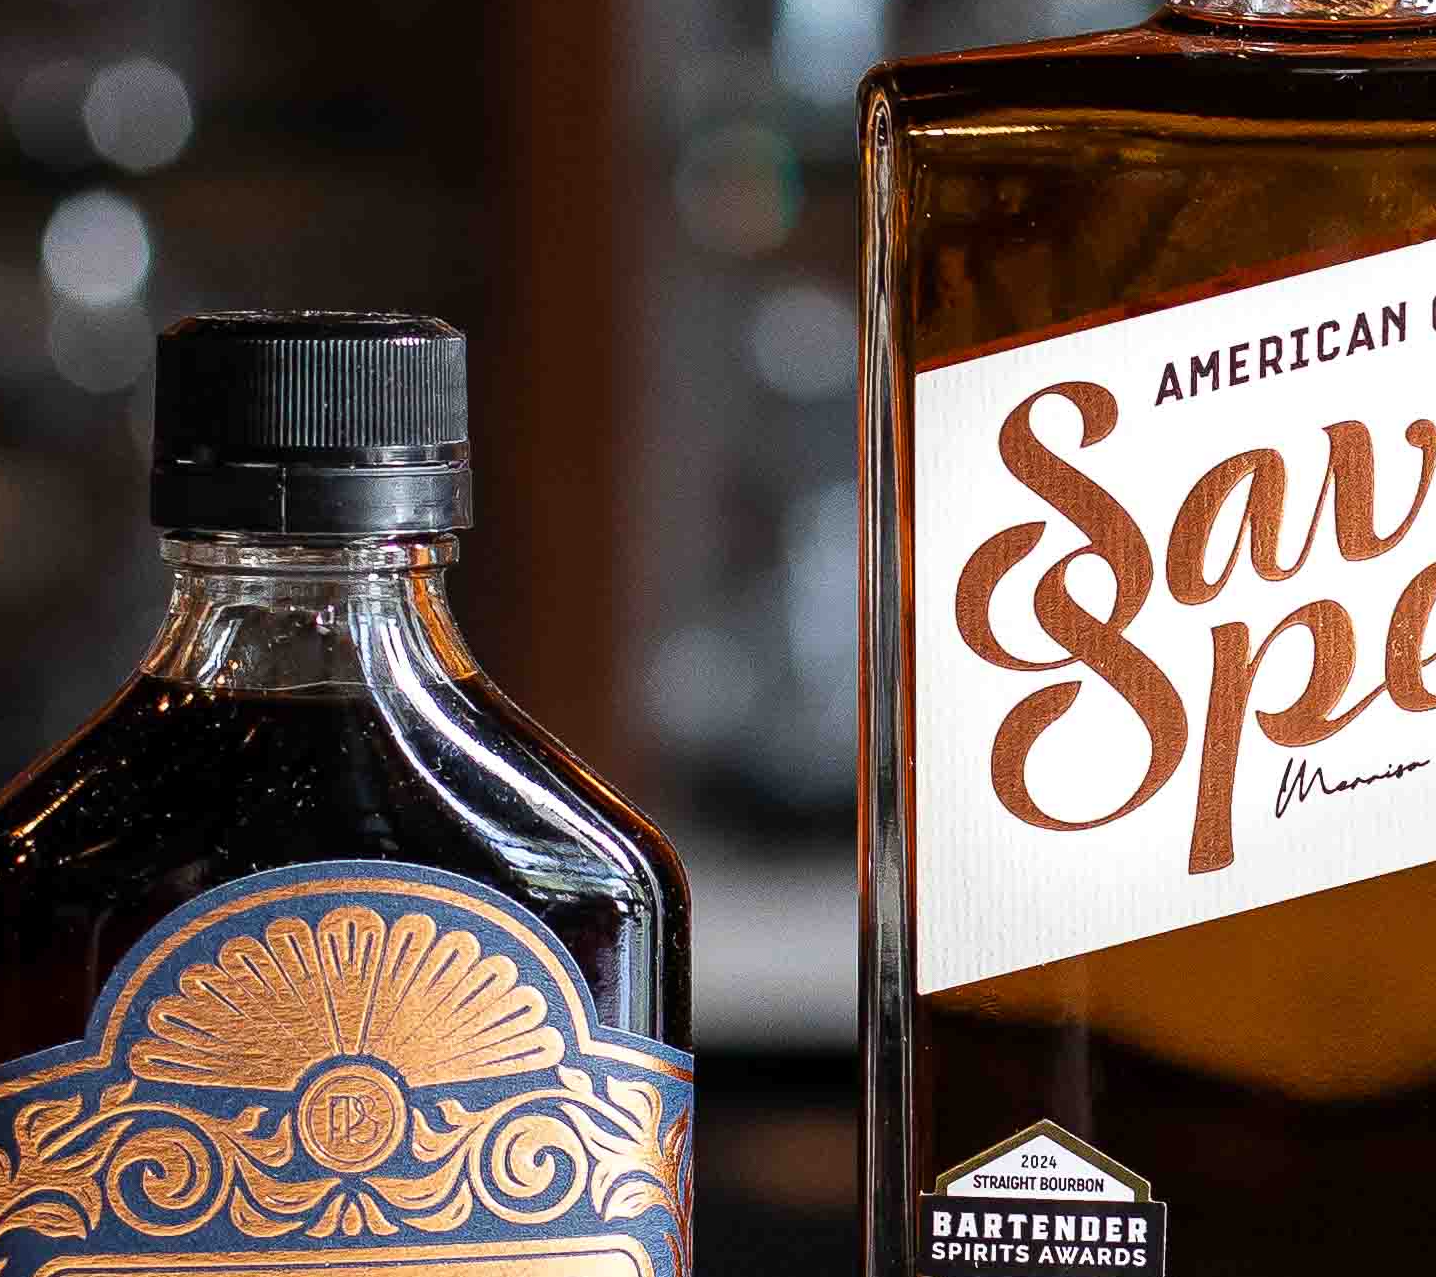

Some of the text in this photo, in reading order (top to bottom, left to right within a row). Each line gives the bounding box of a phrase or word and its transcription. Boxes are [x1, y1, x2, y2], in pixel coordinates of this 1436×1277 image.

[1155, 302, 1408, 406] AMERICAN
[1021, 1155, 1057, 1169] 2024
[973, 1175, 1104, 1192] STRAIGHT BOURBON
[932, 1211, 1148, 1243] BARTENDER
[932, 1242, 1147, 1267] SPIRITS AWARDS
